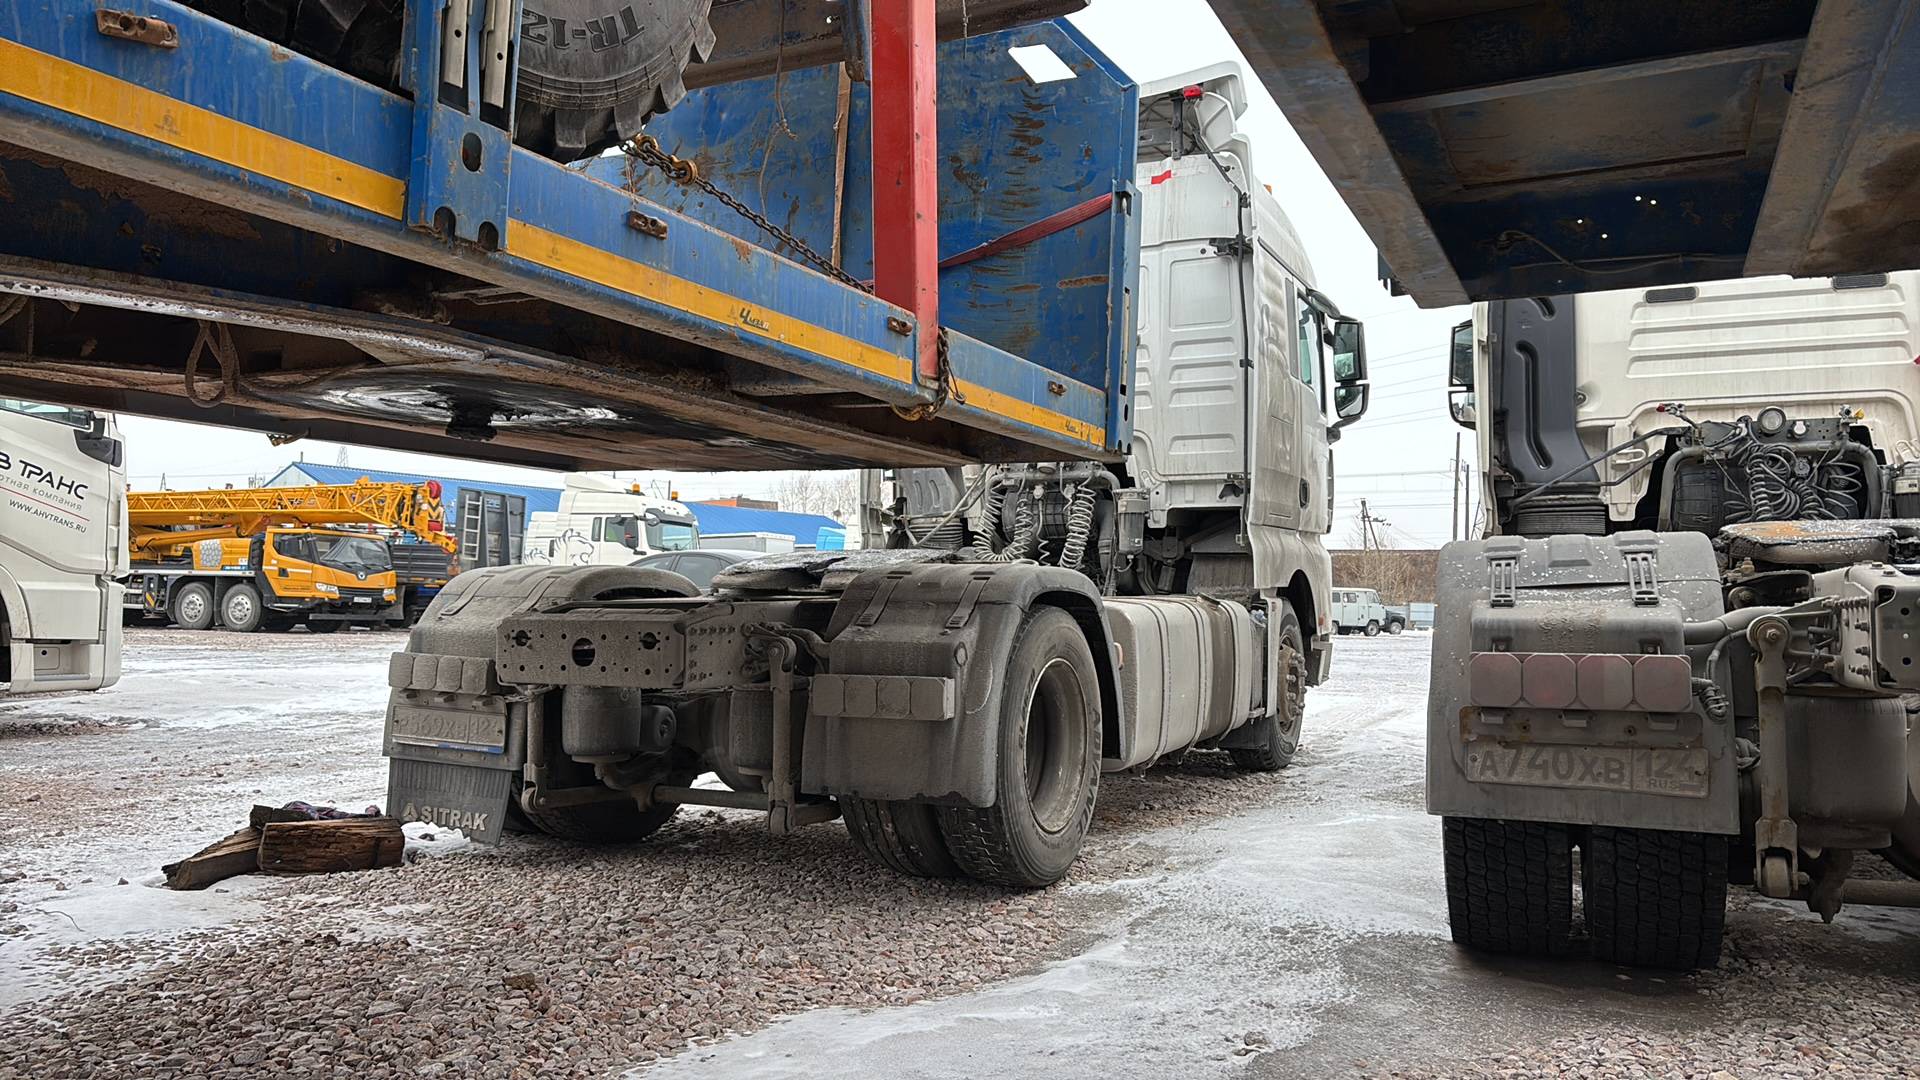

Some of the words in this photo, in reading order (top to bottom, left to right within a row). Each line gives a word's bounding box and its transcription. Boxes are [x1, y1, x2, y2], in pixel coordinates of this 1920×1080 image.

[19, 459, 89, 500] ТРАНС
[9, 499, 87, 533] WWW.AHVTRANS.RU
[32, 487, 83, 512] компания
[1078, 707, 1101, 842] ADVANCE
[1479, 743, 1626, 785] А740ХВ
[420, 806, 488, 831] SITRAK
